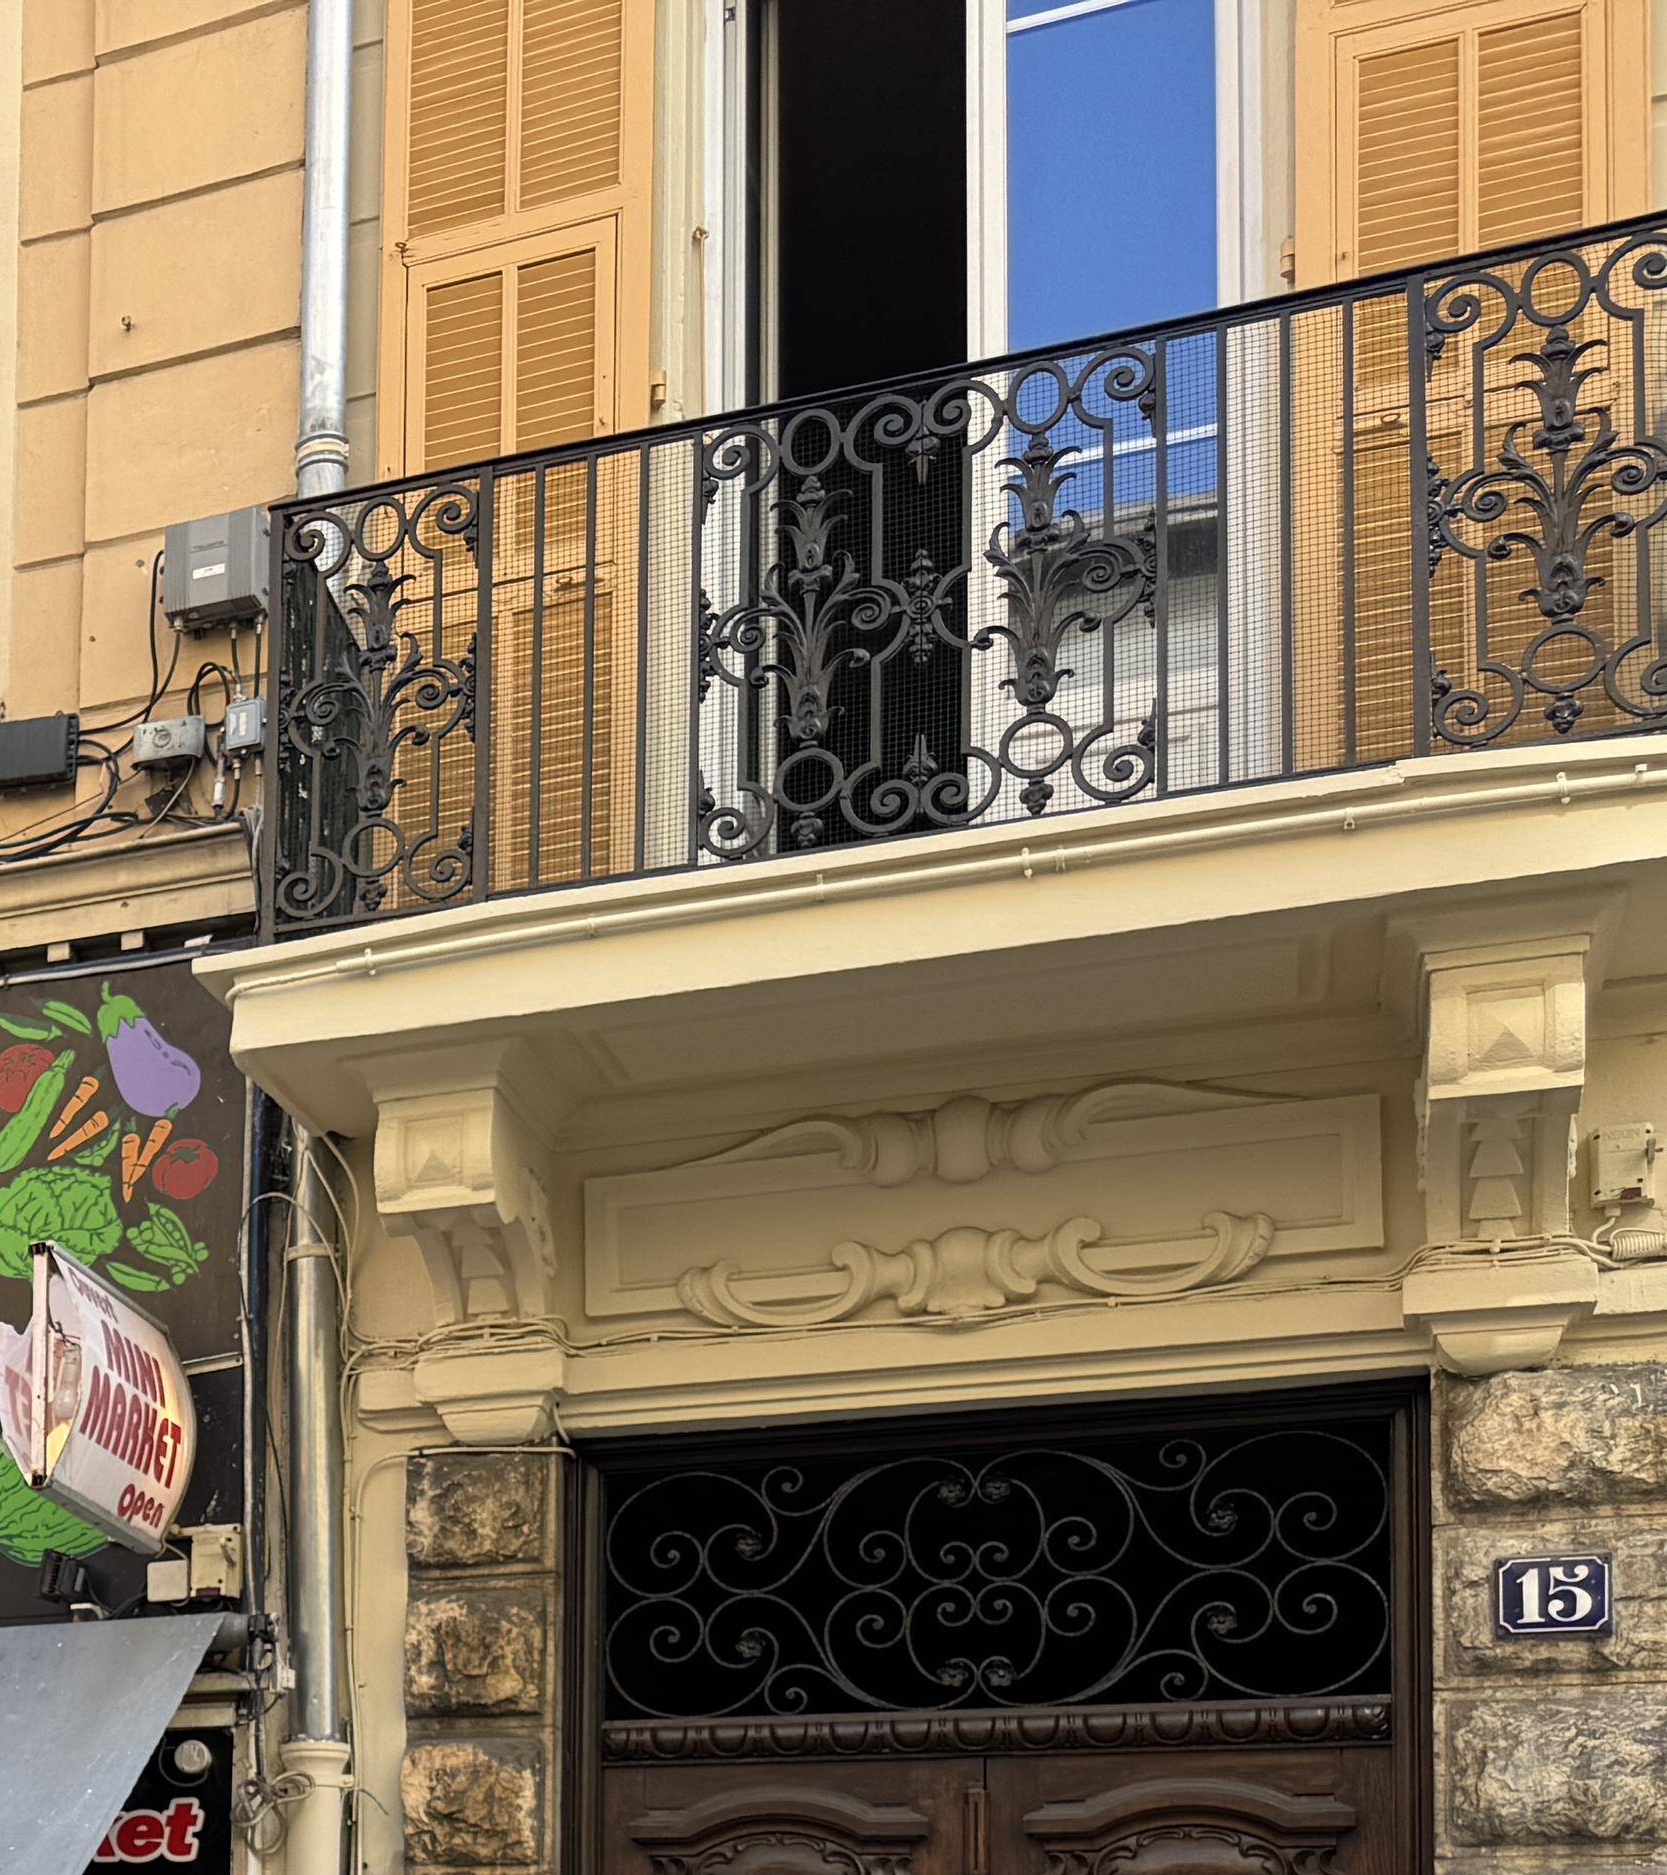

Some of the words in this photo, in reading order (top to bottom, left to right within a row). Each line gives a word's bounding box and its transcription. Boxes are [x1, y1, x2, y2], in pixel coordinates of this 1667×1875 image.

[101, 1318, 167, 1409] MINI
[79, 1364, 182, 1490] MARKET
[1515, 1564, 1593, 1624] 15
